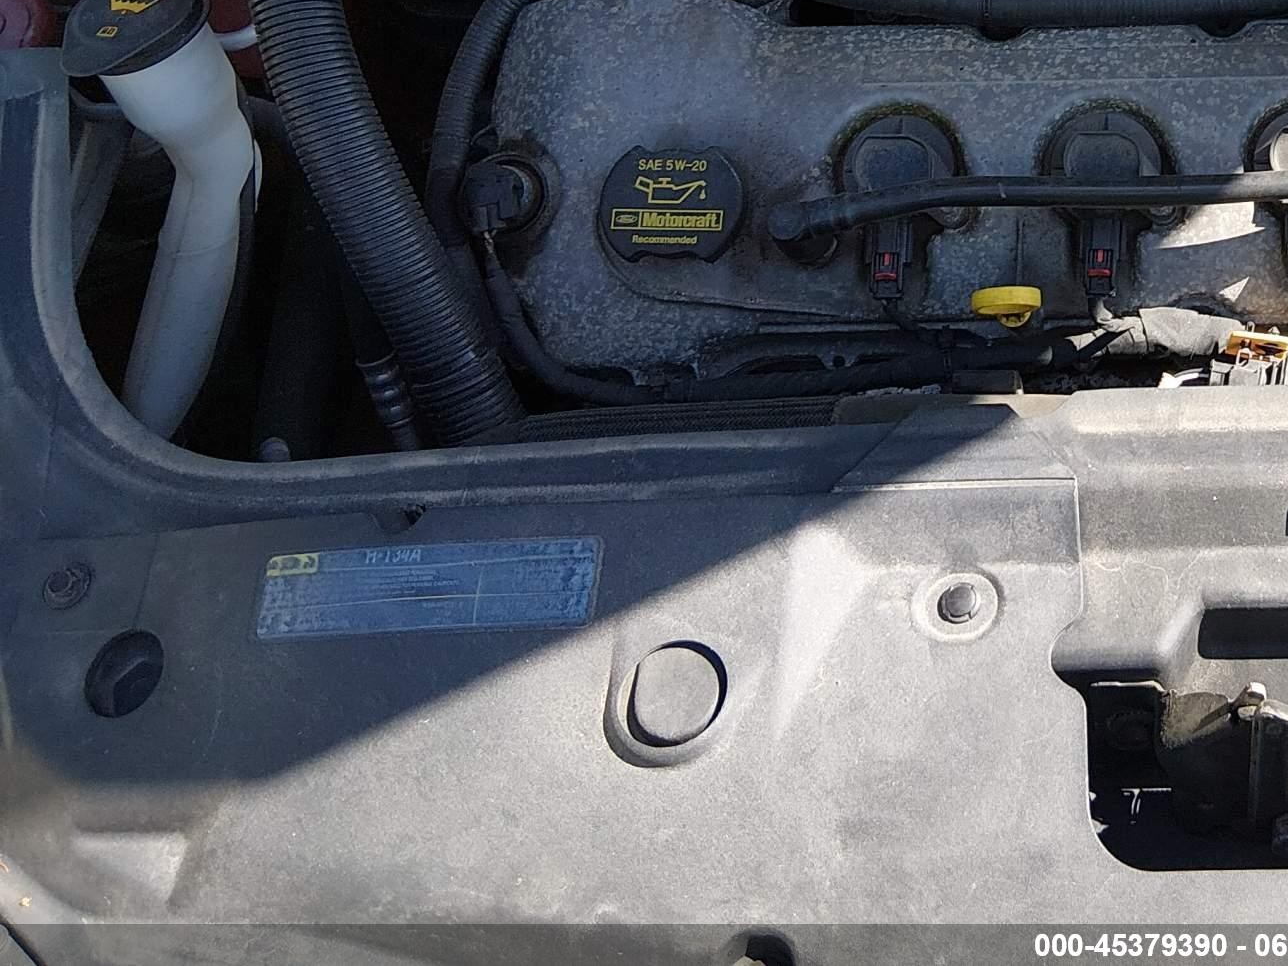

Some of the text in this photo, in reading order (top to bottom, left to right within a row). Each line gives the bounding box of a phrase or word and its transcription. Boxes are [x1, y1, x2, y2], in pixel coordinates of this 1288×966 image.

[638, 159, 707, 172] SAE 5W-20
[642, 212, 719, 228] Motorcraft
[632, 234, 698, 244] Recommended
